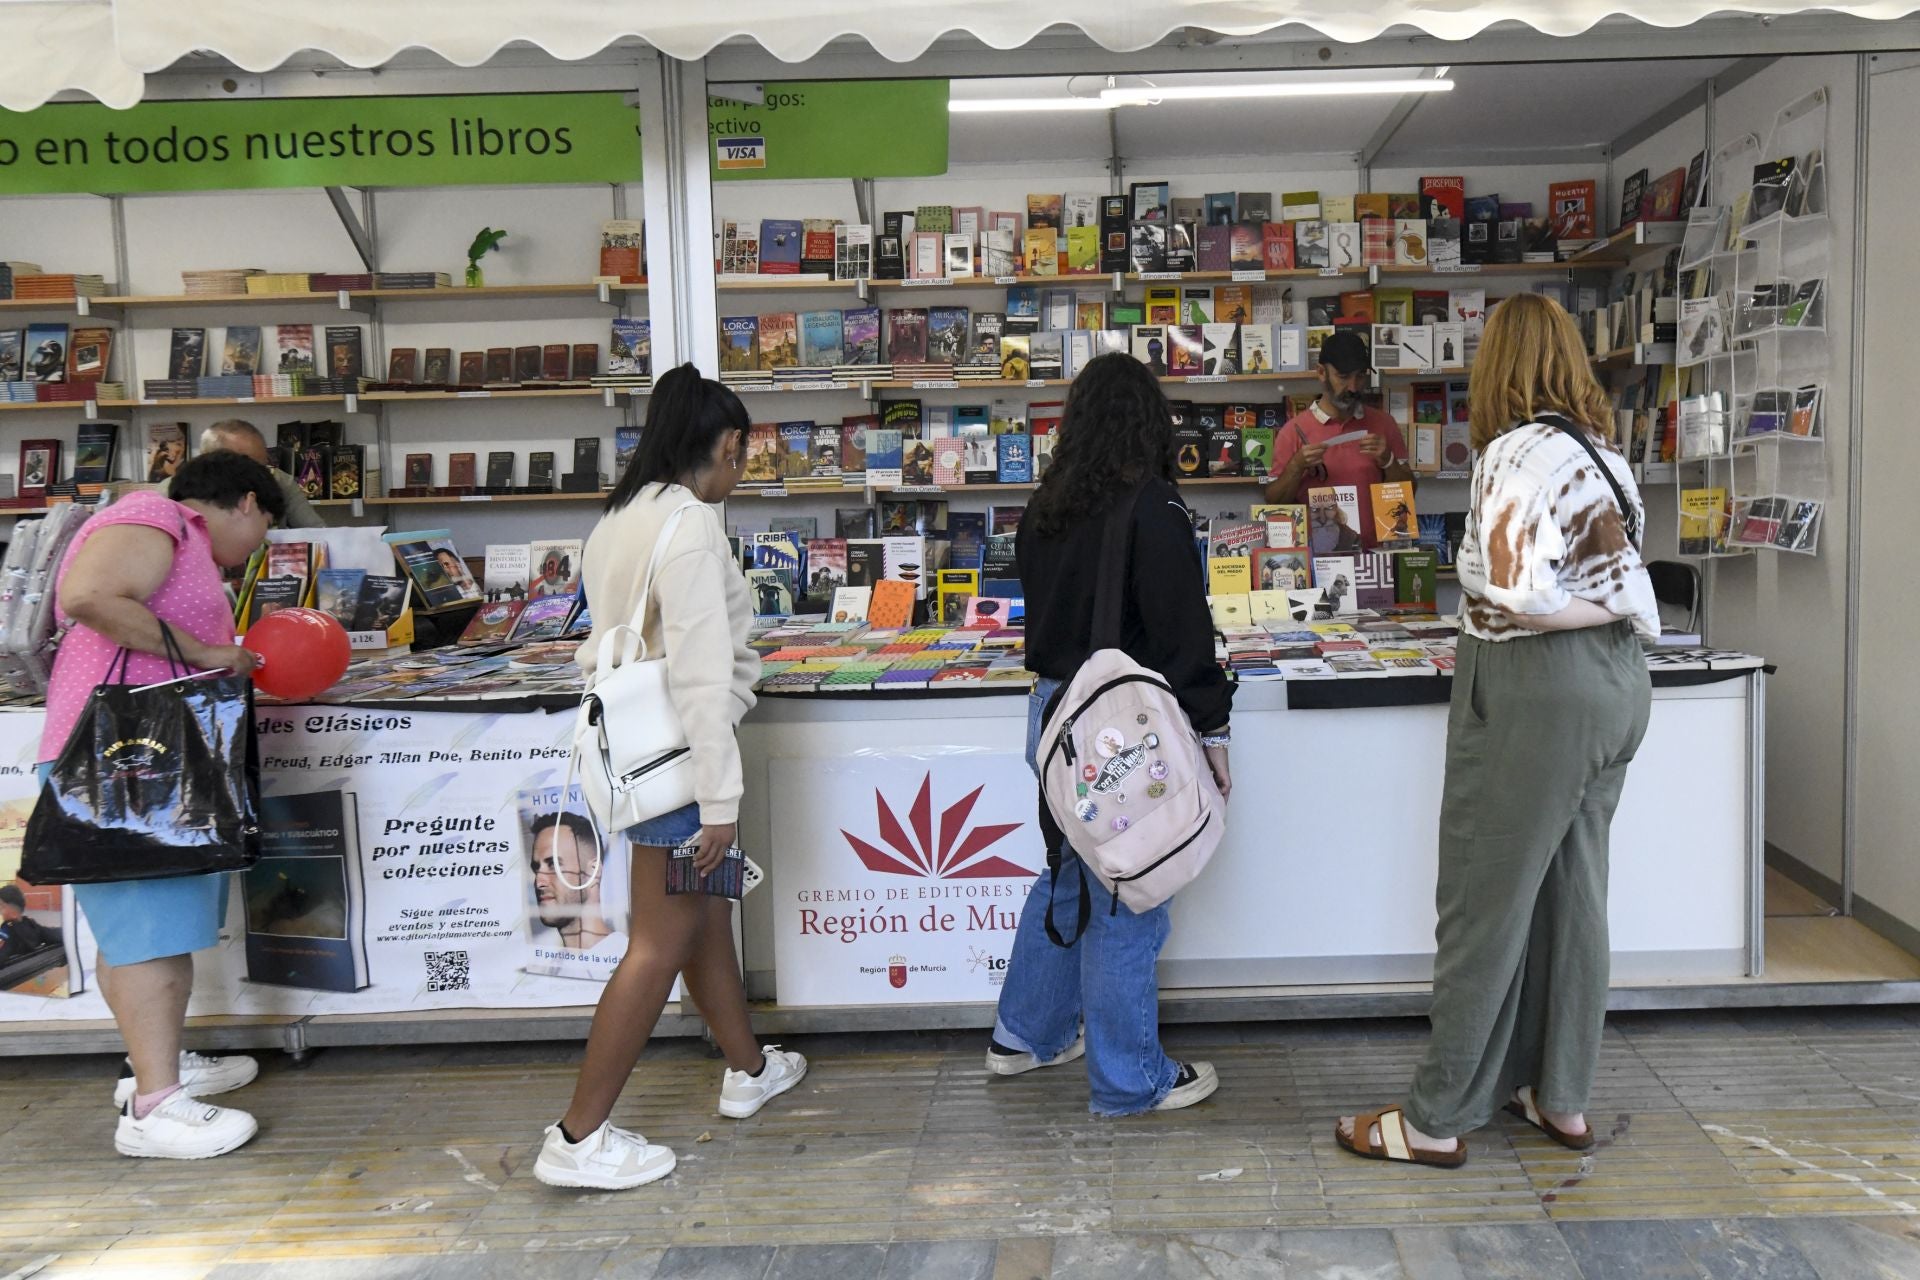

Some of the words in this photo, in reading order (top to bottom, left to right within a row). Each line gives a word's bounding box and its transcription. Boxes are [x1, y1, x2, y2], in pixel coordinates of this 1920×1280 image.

[34, 138, 89, 166] en
[104, 125, 230, 164] todos
[246, 122, 435, 161] nuestros
[450, 116, 573, 156] libros
[727, 146, 758, 159] VISA
[723, 321, 756, 331] LORCA
[977, 326, 1001, 334] WOKE
[780, 426, 811, 435] LORCA
[1212, 434, 1238, 442] ATWOOD
[816, 438, 840, 446] WOKE
[1312, 491, 1355, 503] SÓCRATES
[359, 635, 374, 644] 12€
[256, 716, 294, 735] des
[305, 713, 411, 734] Clásicos
[264, 755, 311, 769] Freud,
[319, 754, 372, 768] Edgar
[379, 751, 421, 765] Allan
[427, 750, 462, 763] Poe,
[469, 747, 522, 762] Benito
[1104, 756, 1124, 774] VANS
[1112, 765, 1128, 784] THE
[383, 813, 495, 837] Pregunte
[372, 843, 408, 861] por
[418, 838, 509, 857] nuestras
[382, 861, 504, 880] colecciones
[797, 888, 876, 903] GREMIO
[886, 887, 909, 900] DE
[918, 884, 1013, 899] EDITORES
[399, 907, 432, 921] Sigue
[438, 905, 489, 917] nuestros
[388, 920, 432, 933] eventos
[438, 922, 445, 932] y
[450, 918, 499, 930] estrenos
[799, 905, 909, 944] Región
[919, 904, 956, 932] de
[965, 904, 1024, 932] Mu
[375, 929, 512, 943] www.editorialplumaverde.com
[534, 948, 543, 958] El
[543, 949, 576, 963] partido
[578, 952, 590, 962] de
[591, 953, 600, 963] la
[860, 965, 887, 978] Región
[920, 964, 947, 973] Murcia
